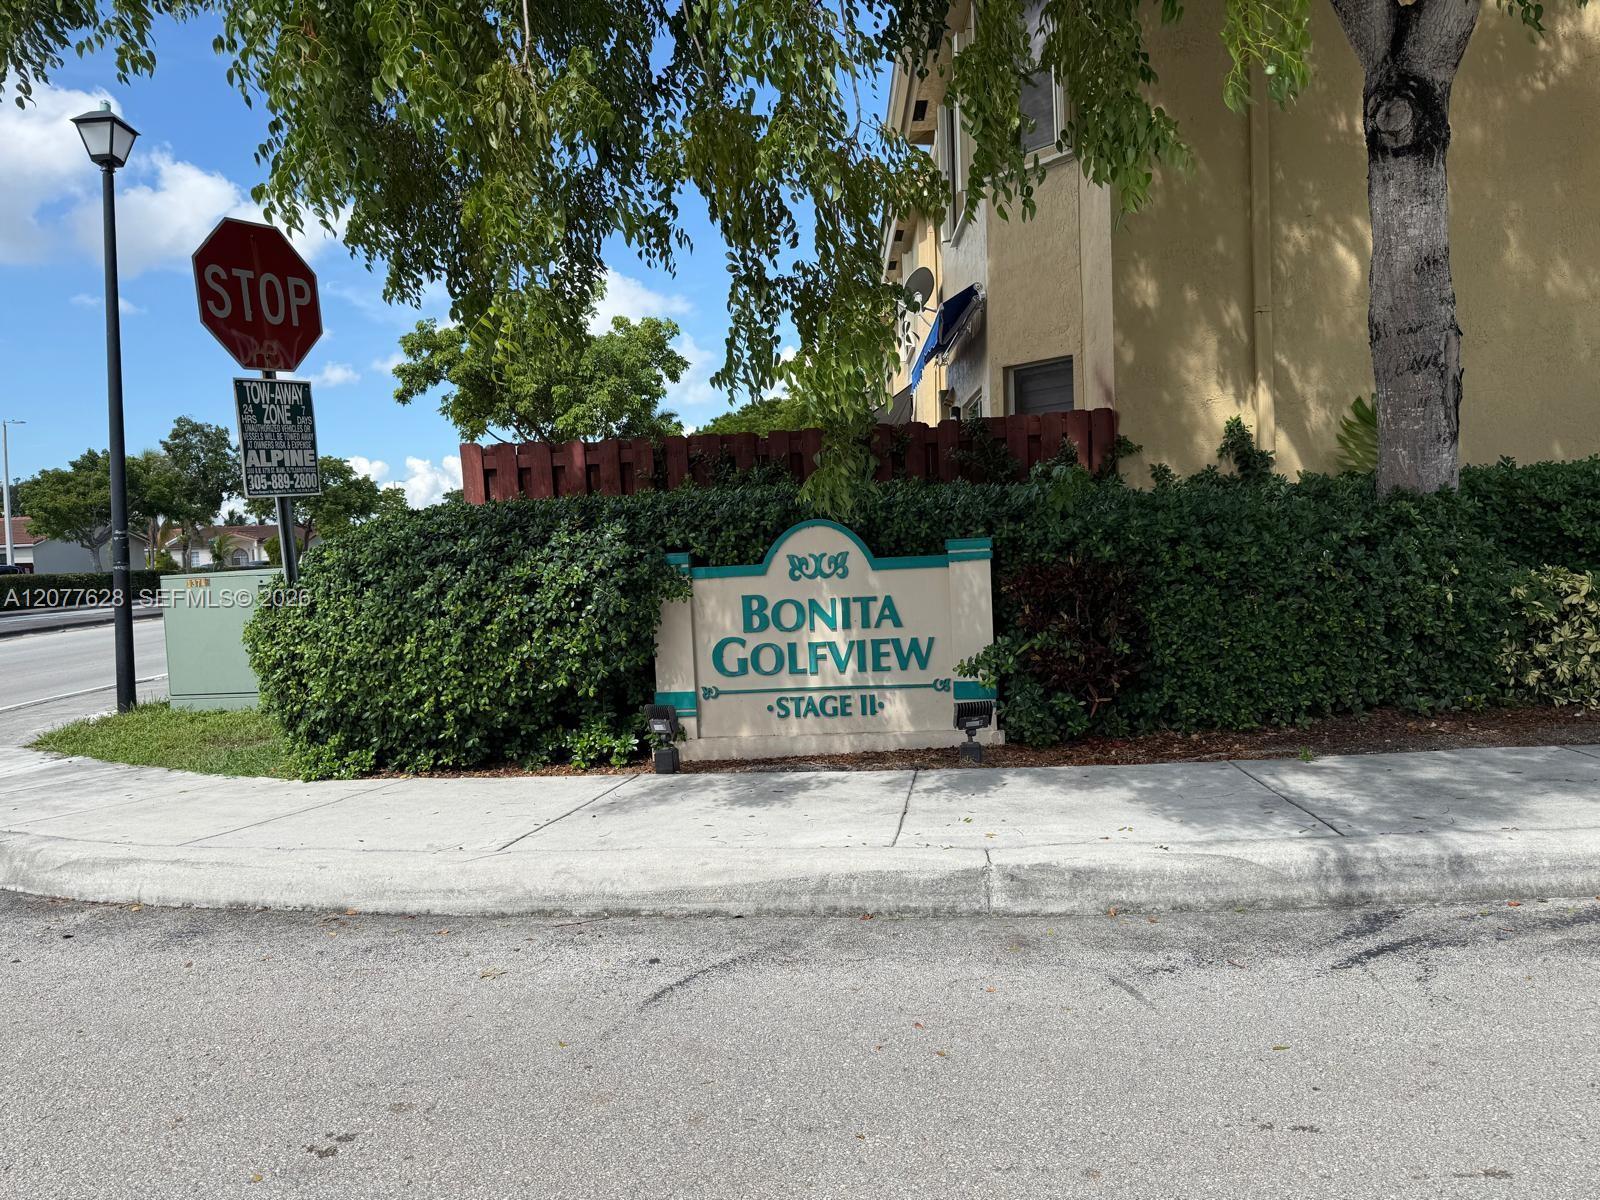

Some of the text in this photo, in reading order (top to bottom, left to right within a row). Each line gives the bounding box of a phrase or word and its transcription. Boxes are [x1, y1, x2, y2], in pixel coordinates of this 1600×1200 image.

[204, 263, 312, 327] STOP
[243, 381, 303, 405] TOW-AWAY
[243, 405, 253, 414] 24
[262, 405, 292, 424] ZONE
[302, 406, 306, 414] 7
[242, 415, 257, 424] HRS
[297, 416, 312, 424] DAYS
[244, 424, 281, 433] UNAUTHORIZED
[281, 424, 303, 433] VEHICLES
[243, 432, 314, 441] VESSELS WILL BE TOWED AWAY
[253, 440, 275, 449] OWNERS
[275, 440, 286, 449] RISK
[291, 440, 312, 449] EXPENSE
[246, 450, 316, 466] ALPINE
[248, 474, 317, 490] 305-889-2800
[741, 594, 904, 634] BONITA
[712, 636, 935, 678] GOLFVIEW
